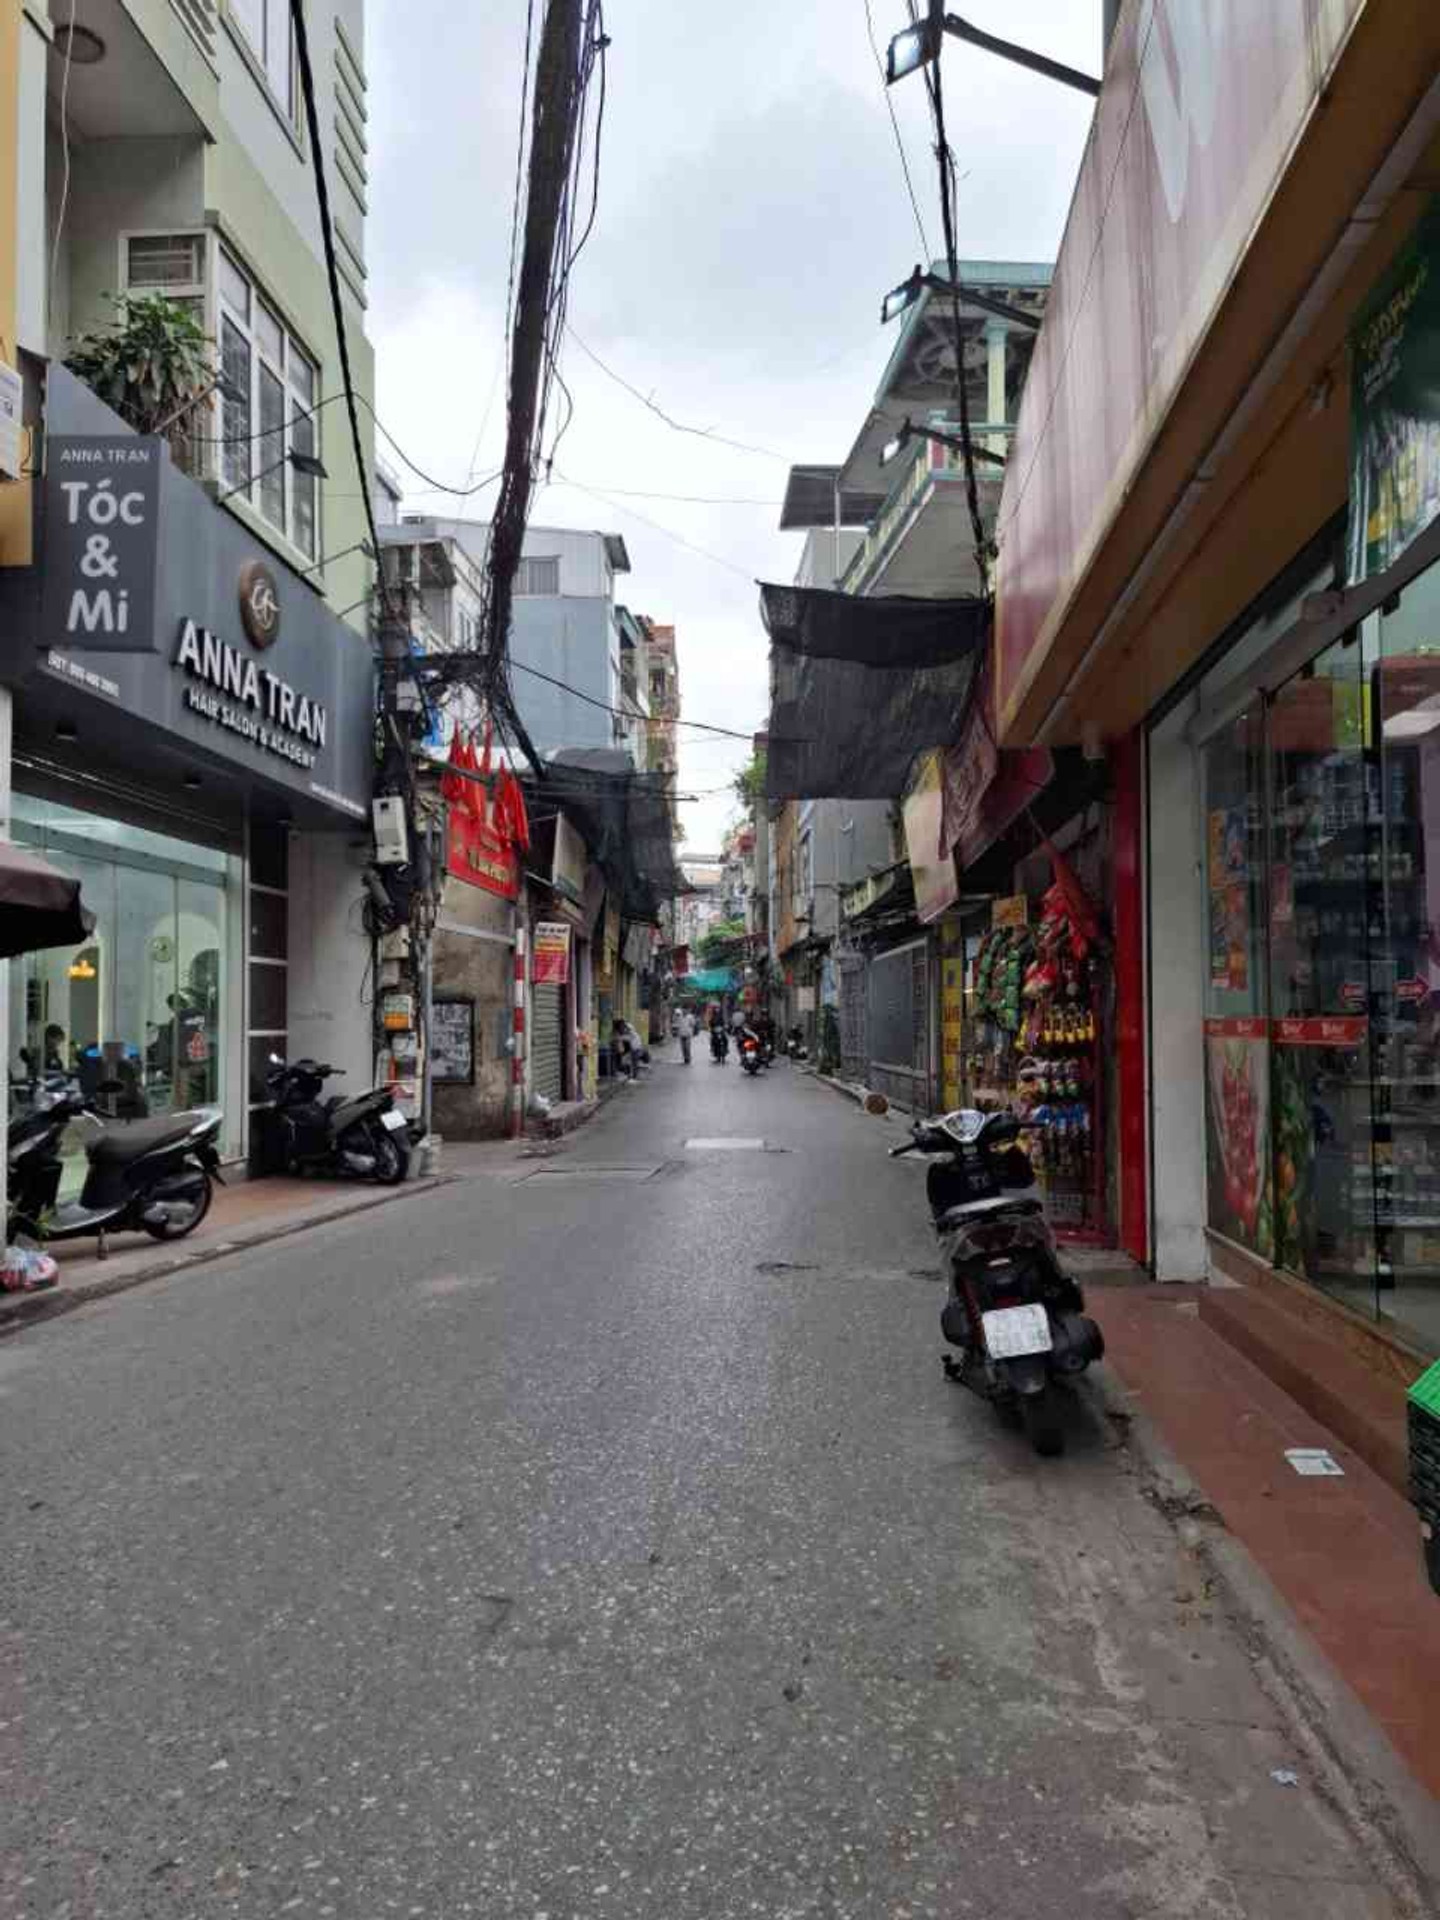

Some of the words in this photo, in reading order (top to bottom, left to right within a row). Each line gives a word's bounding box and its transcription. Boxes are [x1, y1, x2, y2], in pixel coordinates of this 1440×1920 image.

[60, 448, 103, 464] ANNA
[107, 448, 150, 464] TRAN
[60, 478, 145, 525] Tóc
[80, 533, 119, 578] &
[67, 588, 128, 632] Mi
[178, 618, 261, 709] ANNA
[265, 671, 327, 749] TRAN
[189, 686, 220, 718] HAIR
[220, 704, 259, 741] SALON
[259, 727, 268, 746] &
